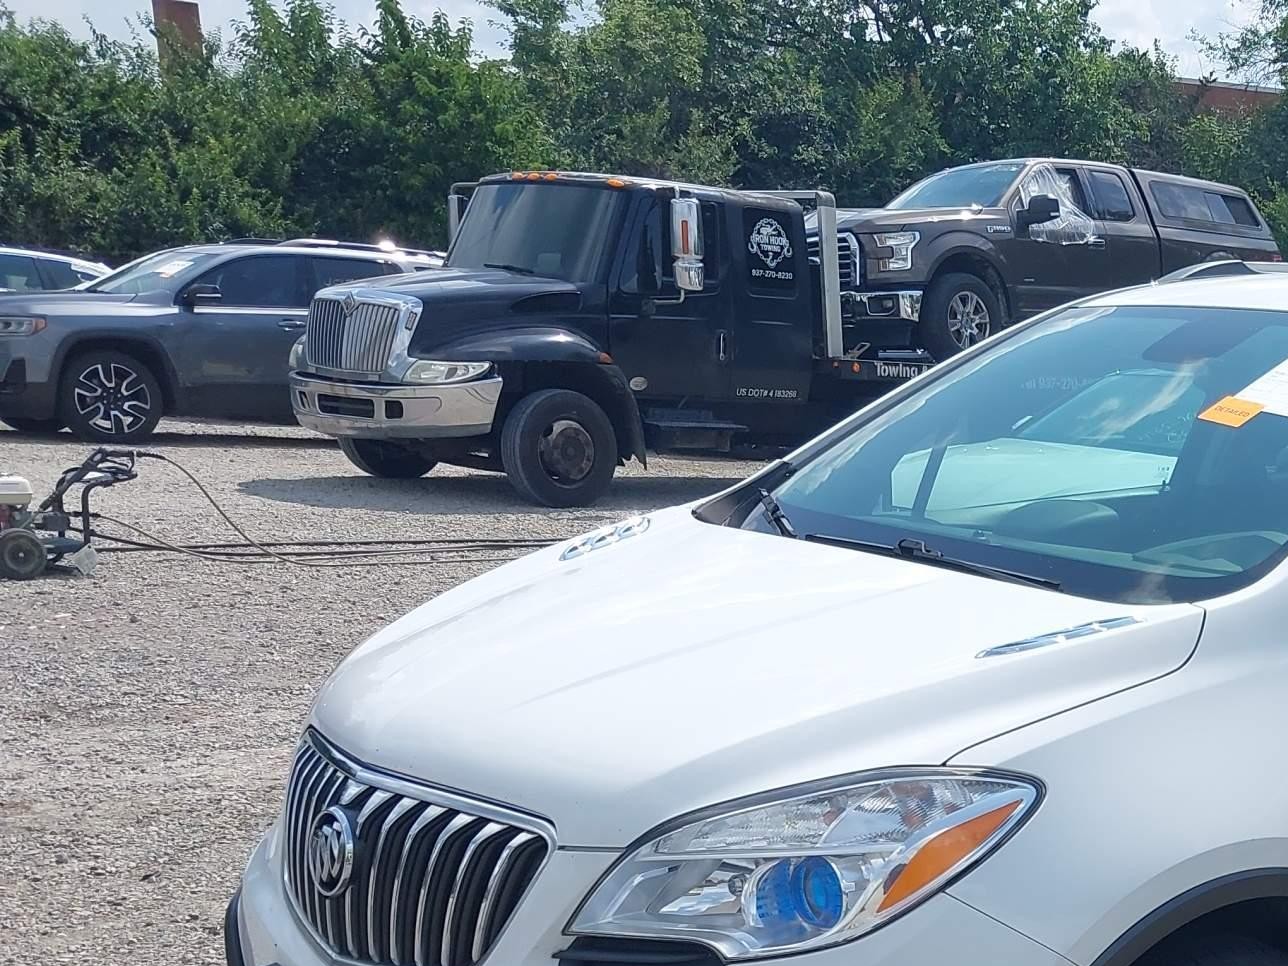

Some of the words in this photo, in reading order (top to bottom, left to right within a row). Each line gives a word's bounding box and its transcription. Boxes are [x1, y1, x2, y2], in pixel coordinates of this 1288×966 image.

[760, 244, 781, 252] TOWING
[874, 361, 918, 379] Towing
[1213, 405, 1250, 418] DETAILED
